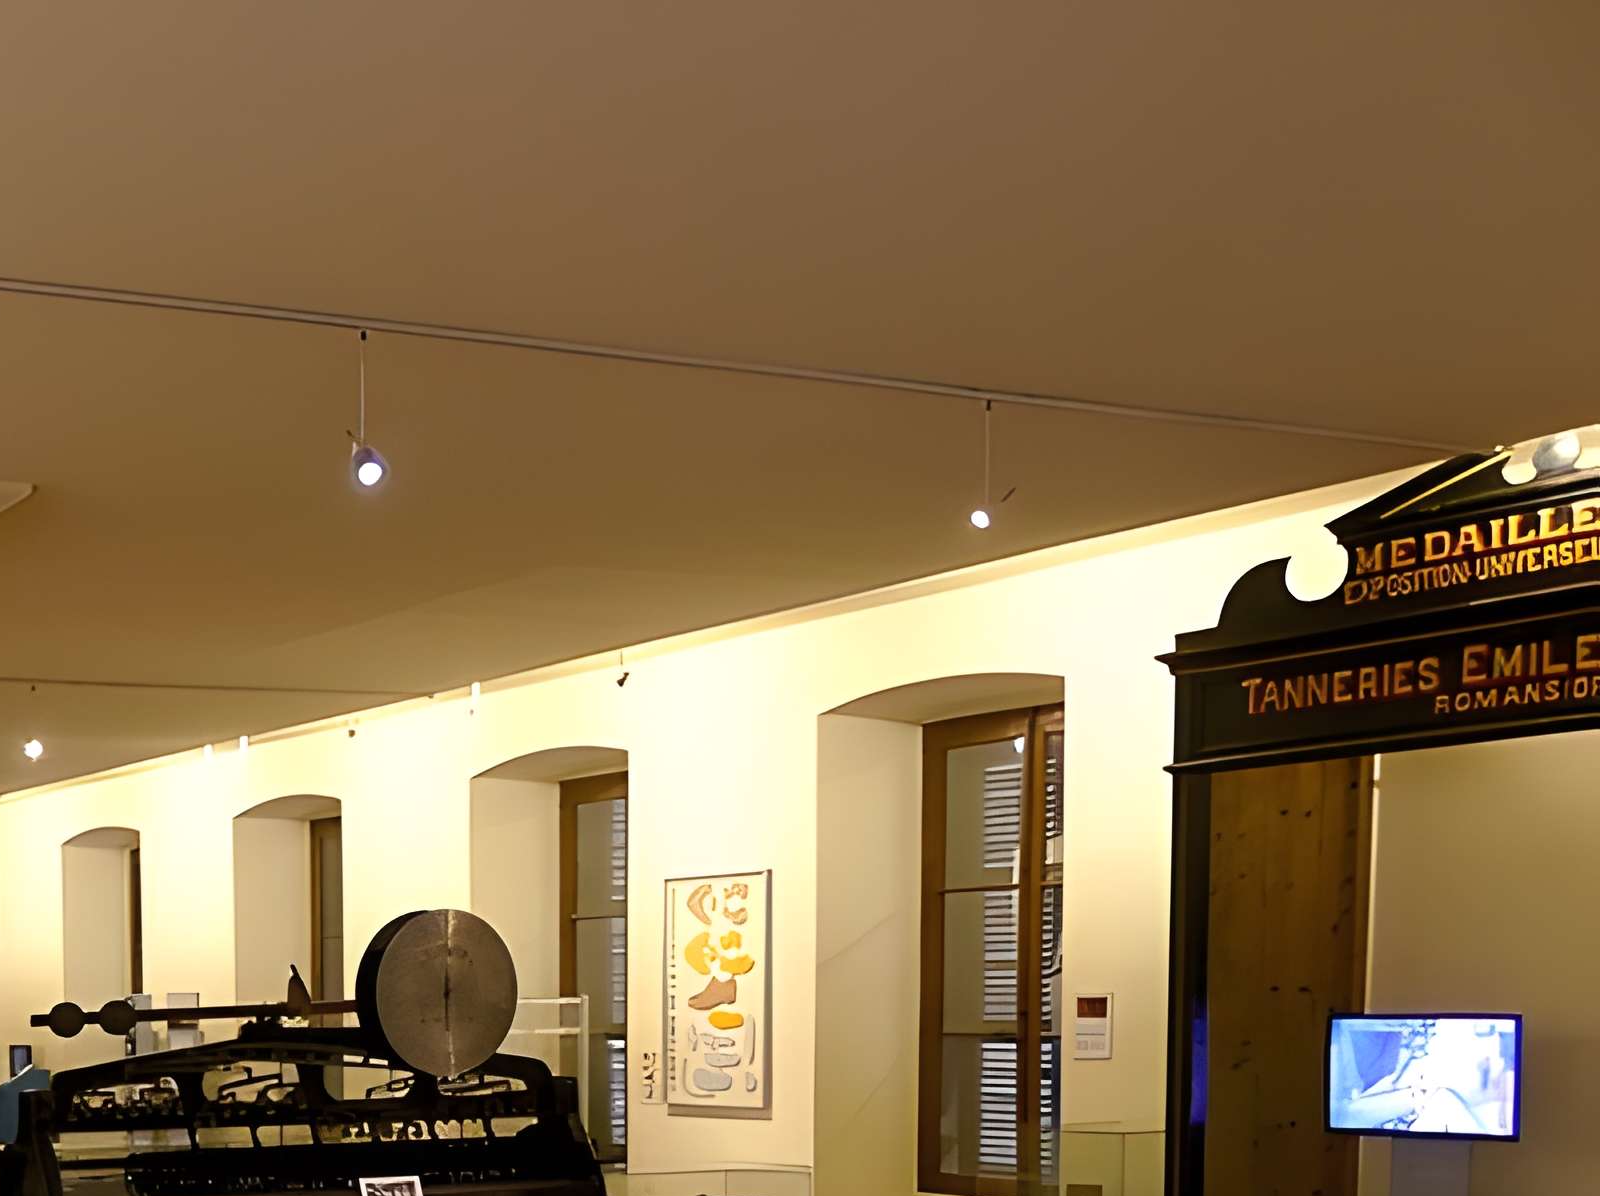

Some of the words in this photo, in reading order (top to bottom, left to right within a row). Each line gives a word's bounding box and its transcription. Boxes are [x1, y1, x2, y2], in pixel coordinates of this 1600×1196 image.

[1356, 497, 1600, 575] MEDAILLE
[1475, 536, 1600, 581] UNIVERSEL
[1241, 656, 1441, 714] TANNERIES
[1462, 633, 1600, 684] EMILE
